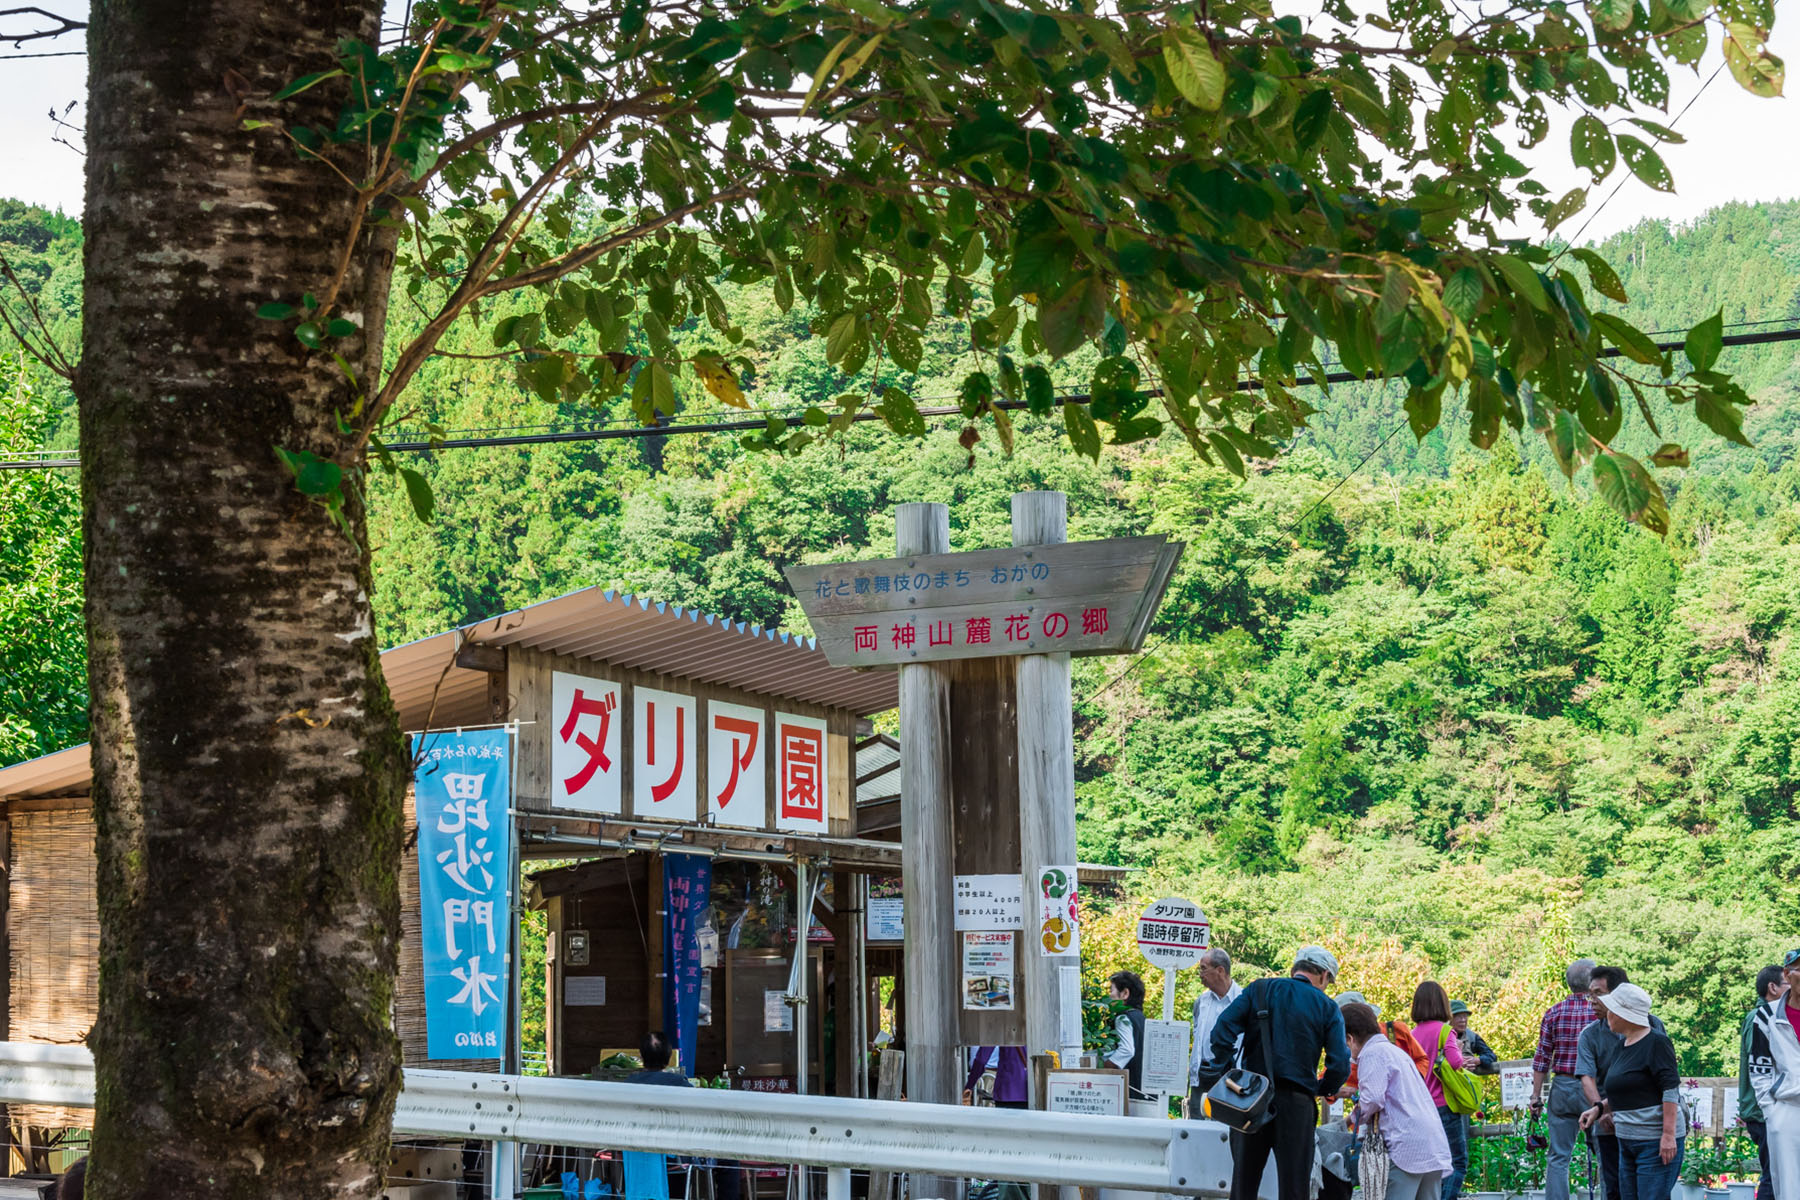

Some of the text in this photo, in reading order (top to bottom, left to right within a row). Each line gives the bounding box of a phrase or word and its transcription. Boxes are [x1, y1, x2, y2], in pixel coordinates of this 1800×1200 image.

[816, 563, 1049, 598] 花と歌舞伎のまち おがの
[854, 607, 1109, 652] 両神山麓花の郷
[559, 688, 822, 823] ダリア園
[1154, 904, 1195, 918] ダリア園
[1142, 923, 1205, 944] 臨時停留所
